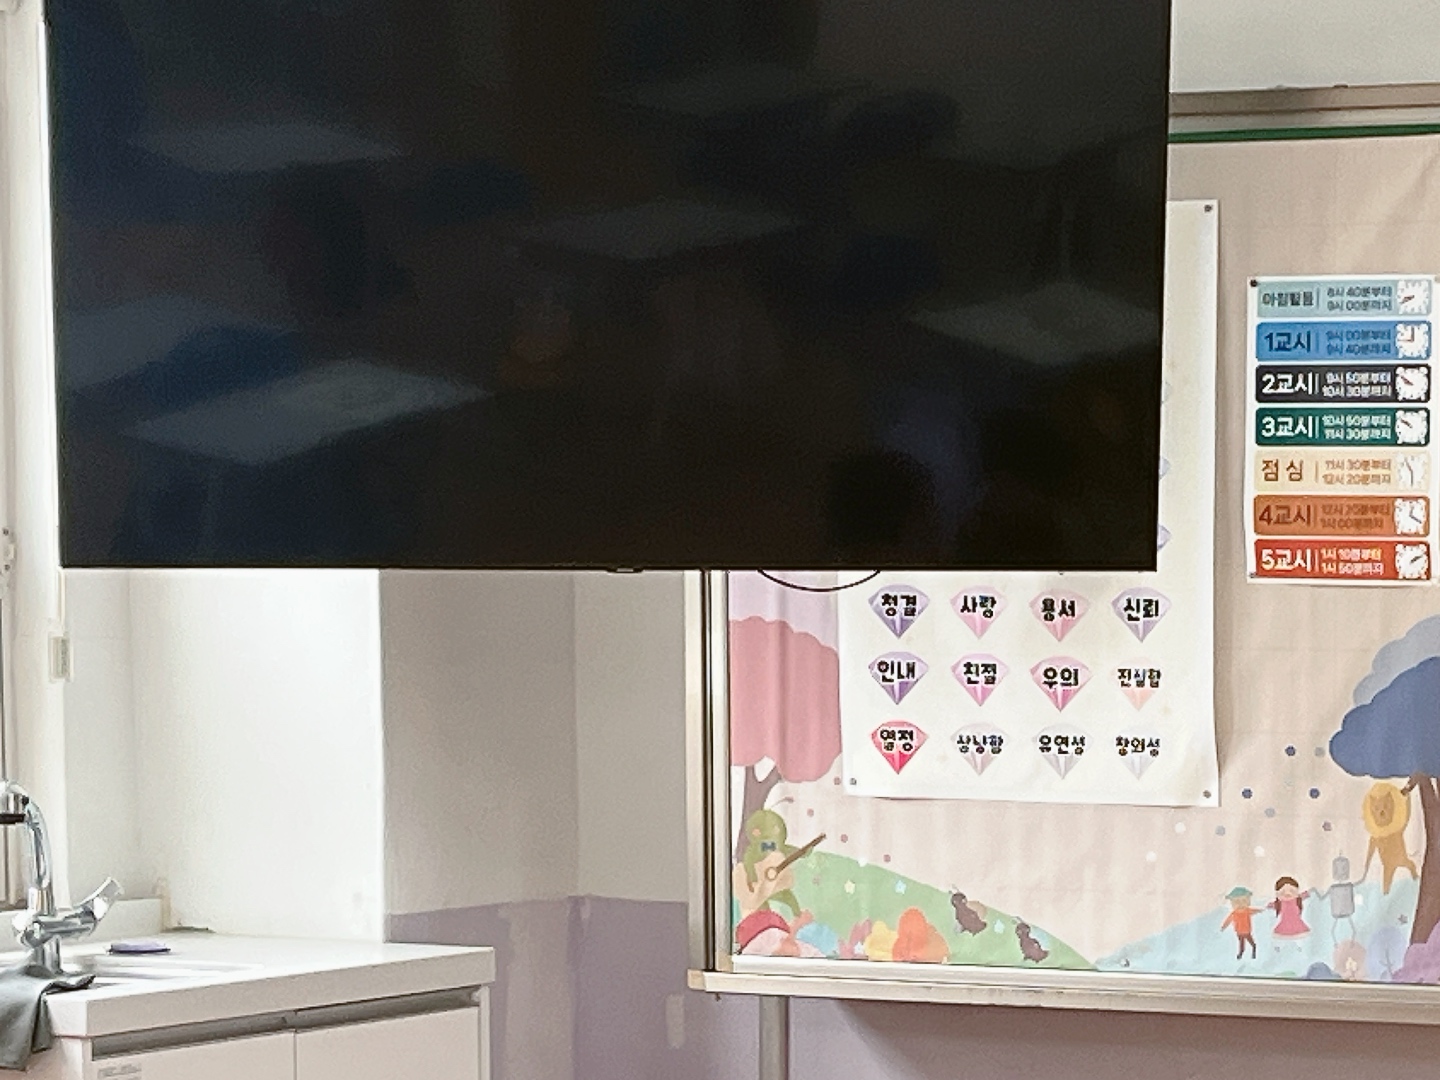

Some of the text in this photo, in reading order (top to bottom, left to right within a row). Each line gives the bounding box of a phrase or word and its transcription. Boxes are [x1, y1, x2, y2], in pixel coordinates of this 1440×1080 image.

[1264, 331, 1311, 353] 1교시
[1261, 371, 1314, 395] 2교시
[1261, 415, 1313, 438] 3교시
[1258, 504, 1311, 527] 4교시
[1261, 548, 1312, 572] 5교시
[881, 593, 917, 617] 청결
[960, 594, 997, 619] 사랑
[1041, 598, 1076, 622] 용서
[1123, 598, 1160, 622] 신뢰
[877, 660, 916, 683] 인내
[963, 661, 998, 686] 친절
[1042, 666, 1080, 688] 우의
[880, 729, 914, 752] 열정
[1039, 734, 1086, 756] 유연성
[1115, 736, 1161, 757] 창의성
